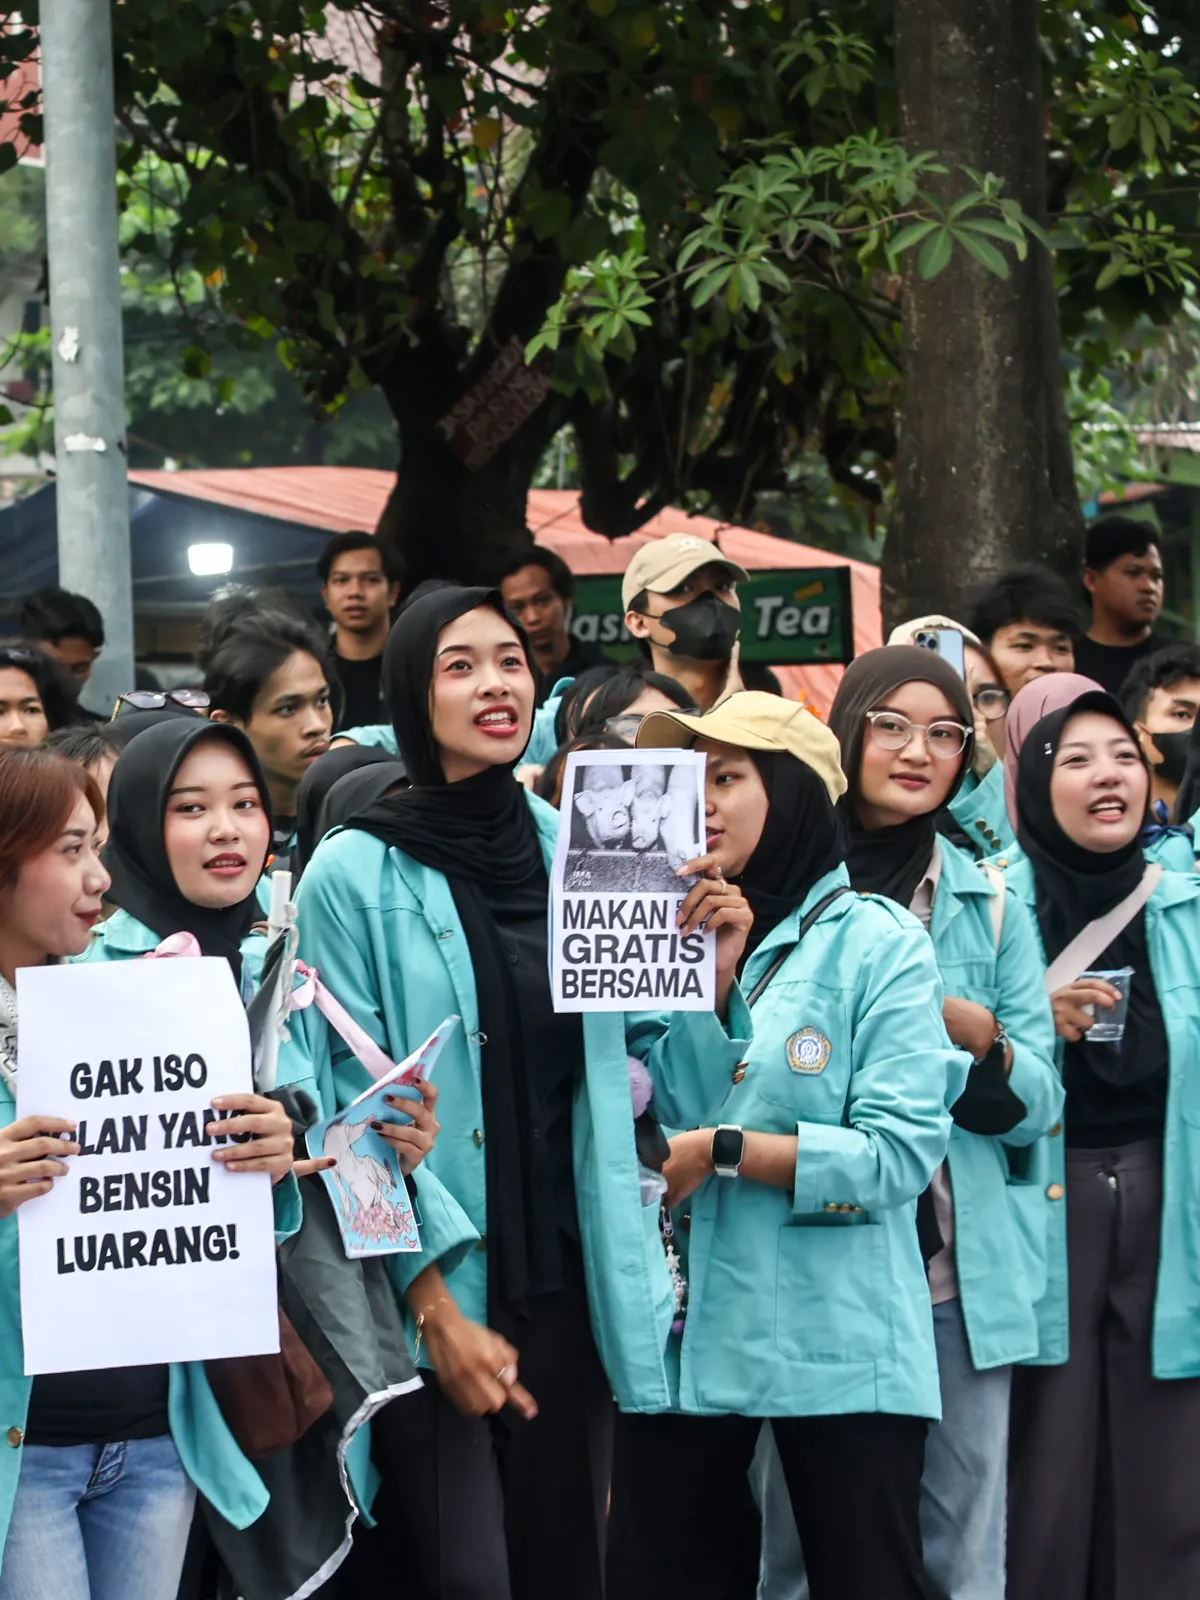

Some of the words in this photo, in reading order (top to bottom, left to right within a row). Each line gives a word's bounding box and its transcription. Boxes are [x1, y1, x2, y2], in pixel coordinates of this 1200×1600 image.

[755, 596, 831, 637] Tea
[562, 899, 668, 929] MAKAN
[562, 933, 705, 965] GRATIS
[562, 967, 704, 999] BERSAMA
[70, 1058, 144, 1099] GAK
[153, 1053, 208, 1092] ISO
[40, 1115, 148, 1158] LAN
[79, 1167, 210, 1214] BENSIN
[57, 1224, 240, 1275] LUARANG!
